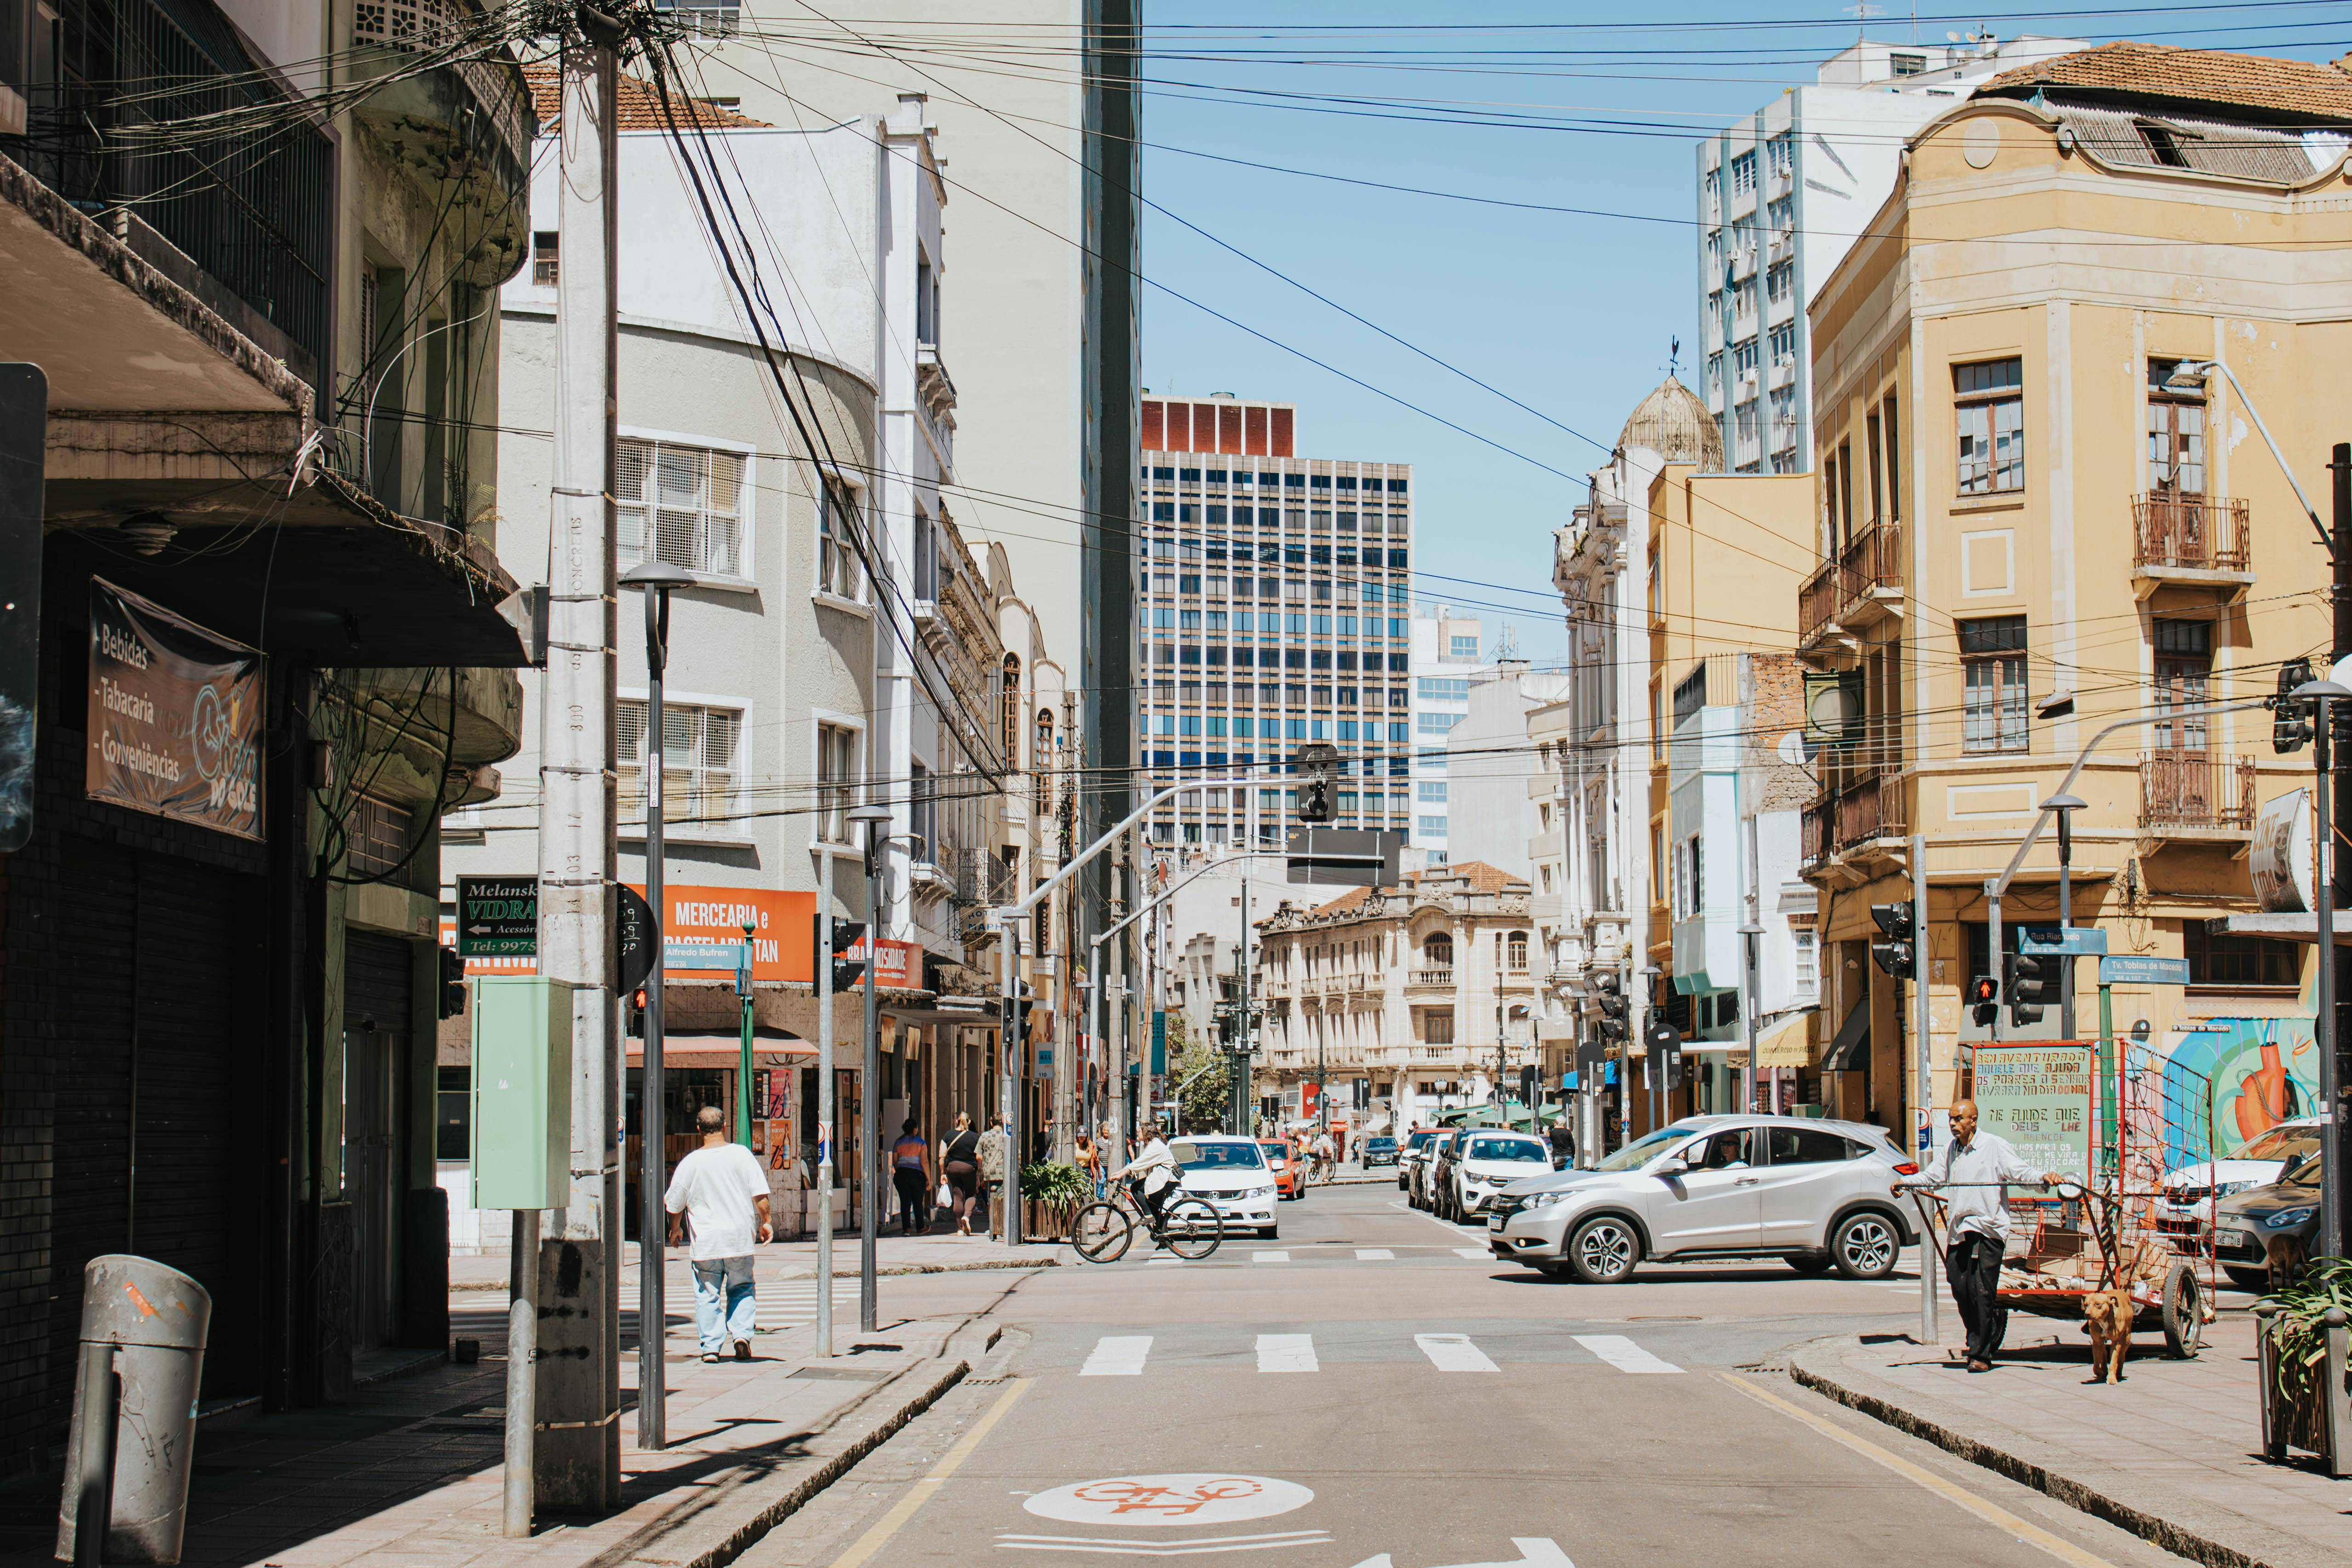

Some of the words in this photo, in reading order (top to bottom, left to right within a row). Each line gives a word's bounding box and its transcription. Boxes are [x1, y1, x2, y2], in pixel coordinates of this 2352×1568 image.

[102, 623, 148, 670] Bebidas
[101, 676, 154, 724] Tabacaria
[102, 730, 179, 782] Conveniências
[210, 778, 226, 809] DO
[228, 778, 256, 812] GOLE
[2253, 812, 2280, 853] CINE
[675, 902, 759, 928] MERCEARIA
[761, 911, 768, 929] e
[2047, 933, 2080, 941] Riachuelo
[471, 941, 496, 951] Tel:
[500, 942, 537, 951] 9975
[753, 939, 778, 963] TAN
[666, 948, 697, 956] Alfredo
[699, 949, 728, 957] Bufren
[847, 945, 906, 970] BRAMOSIDADE
[2124, 961, 2147, 970] Tobias
[2149, 962, 2157, 970] de
[2159, 963, 2182, 972] Macedo
[1762, 1045, 1792, 1054] COMÉRCIO
[2045, 1063, 2080, 1073] AJUDA
[1977, 1076, 1989, 1085] OS
[1994, 1074, 2036, 1085] POBRES
[2051, 1074, 2090, 1084] SENHOR
[2010, 1122, 2039, 1132] DEUS
[2061, 1121, 2082, 1132] LHE
[2020, 1151, 2042, 1159] ONDE
[2044, 1151, 2055, 1159] ME
